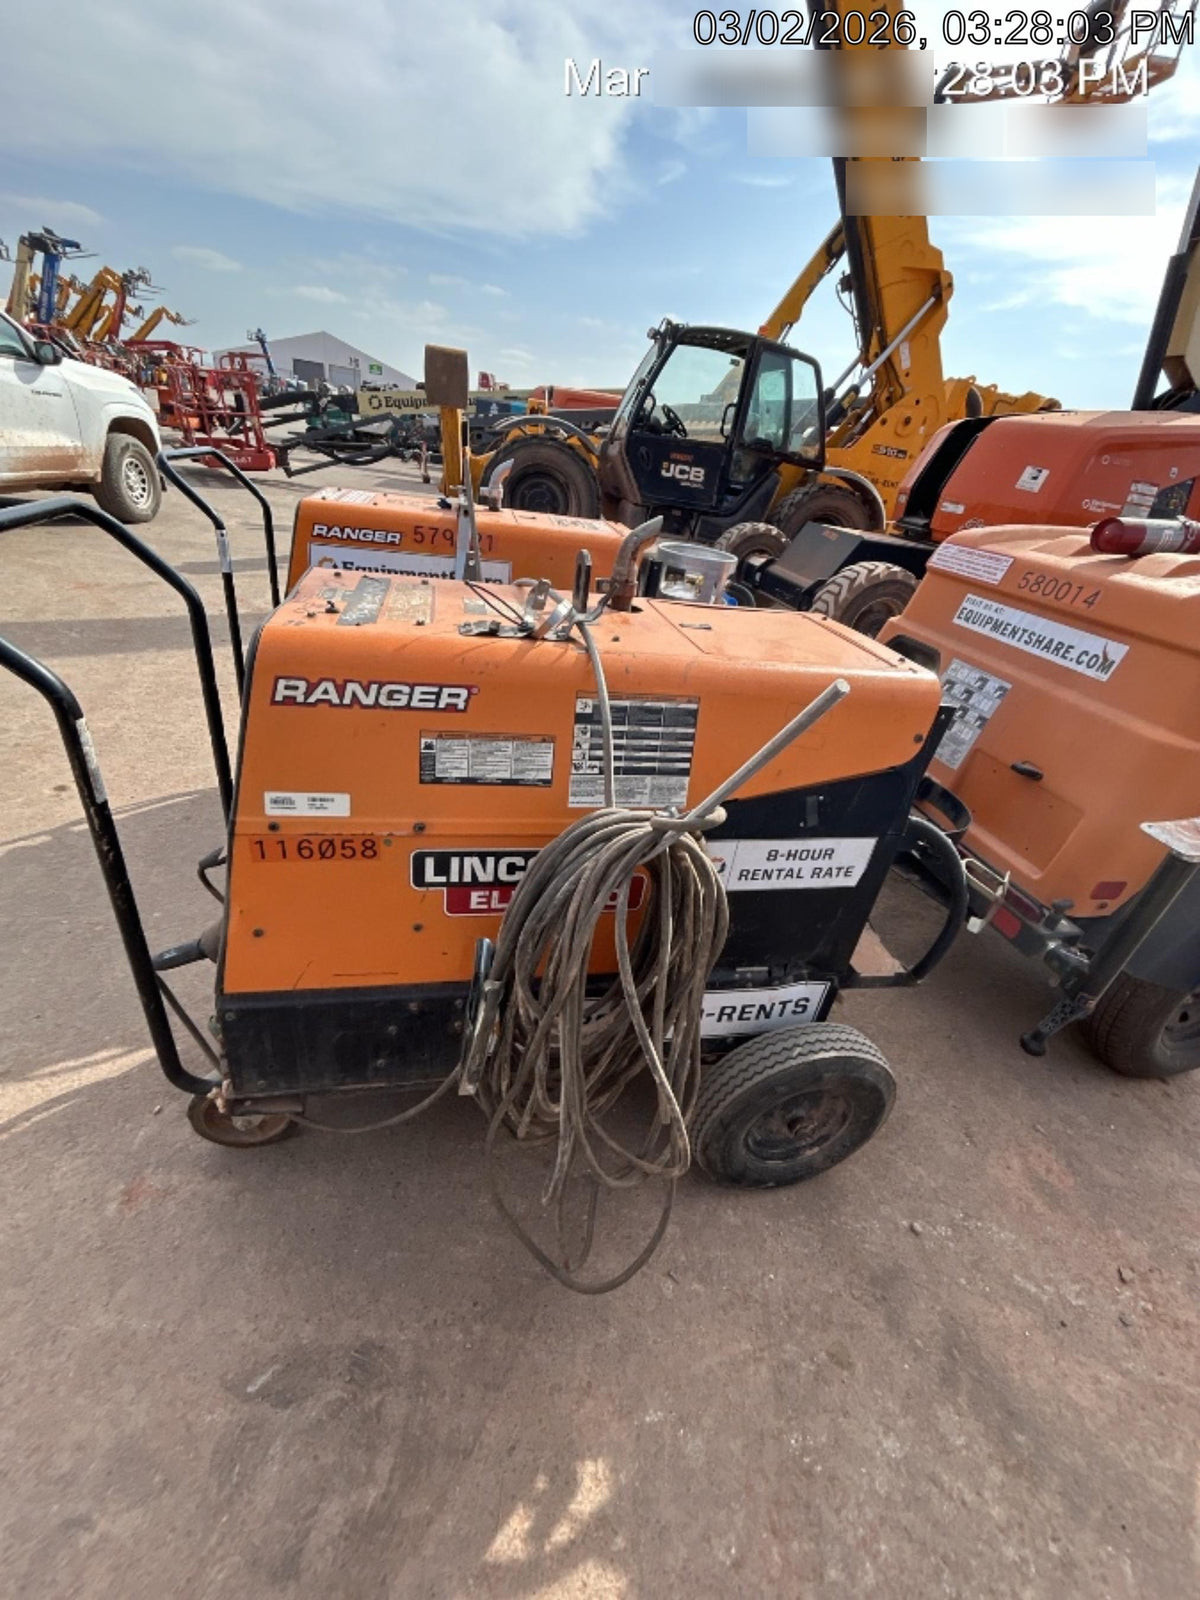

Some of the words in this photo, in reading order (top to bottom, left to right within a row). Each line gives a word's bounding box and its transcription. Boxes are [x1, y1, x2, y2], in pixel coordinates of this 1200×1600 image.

[661, 462, 705, 482] JCB
[312, 523, 402, 545] RANGER
[413, 525, 494, 552] 5791
[1017, 571, 1102, 609] 580014
[956, 606, 1117, 677] EQUIPMENTSHARE.COM
[253, 838, 378, 860] 116058
[766, 848, 835, 863] 8-HOUR
[424, 856, 530, 883] LINC
[737, 867, 805, 882] RENTAL
[810, 865, 856, 880] RATE
[700, 996, 811, 1024] -RENTS
